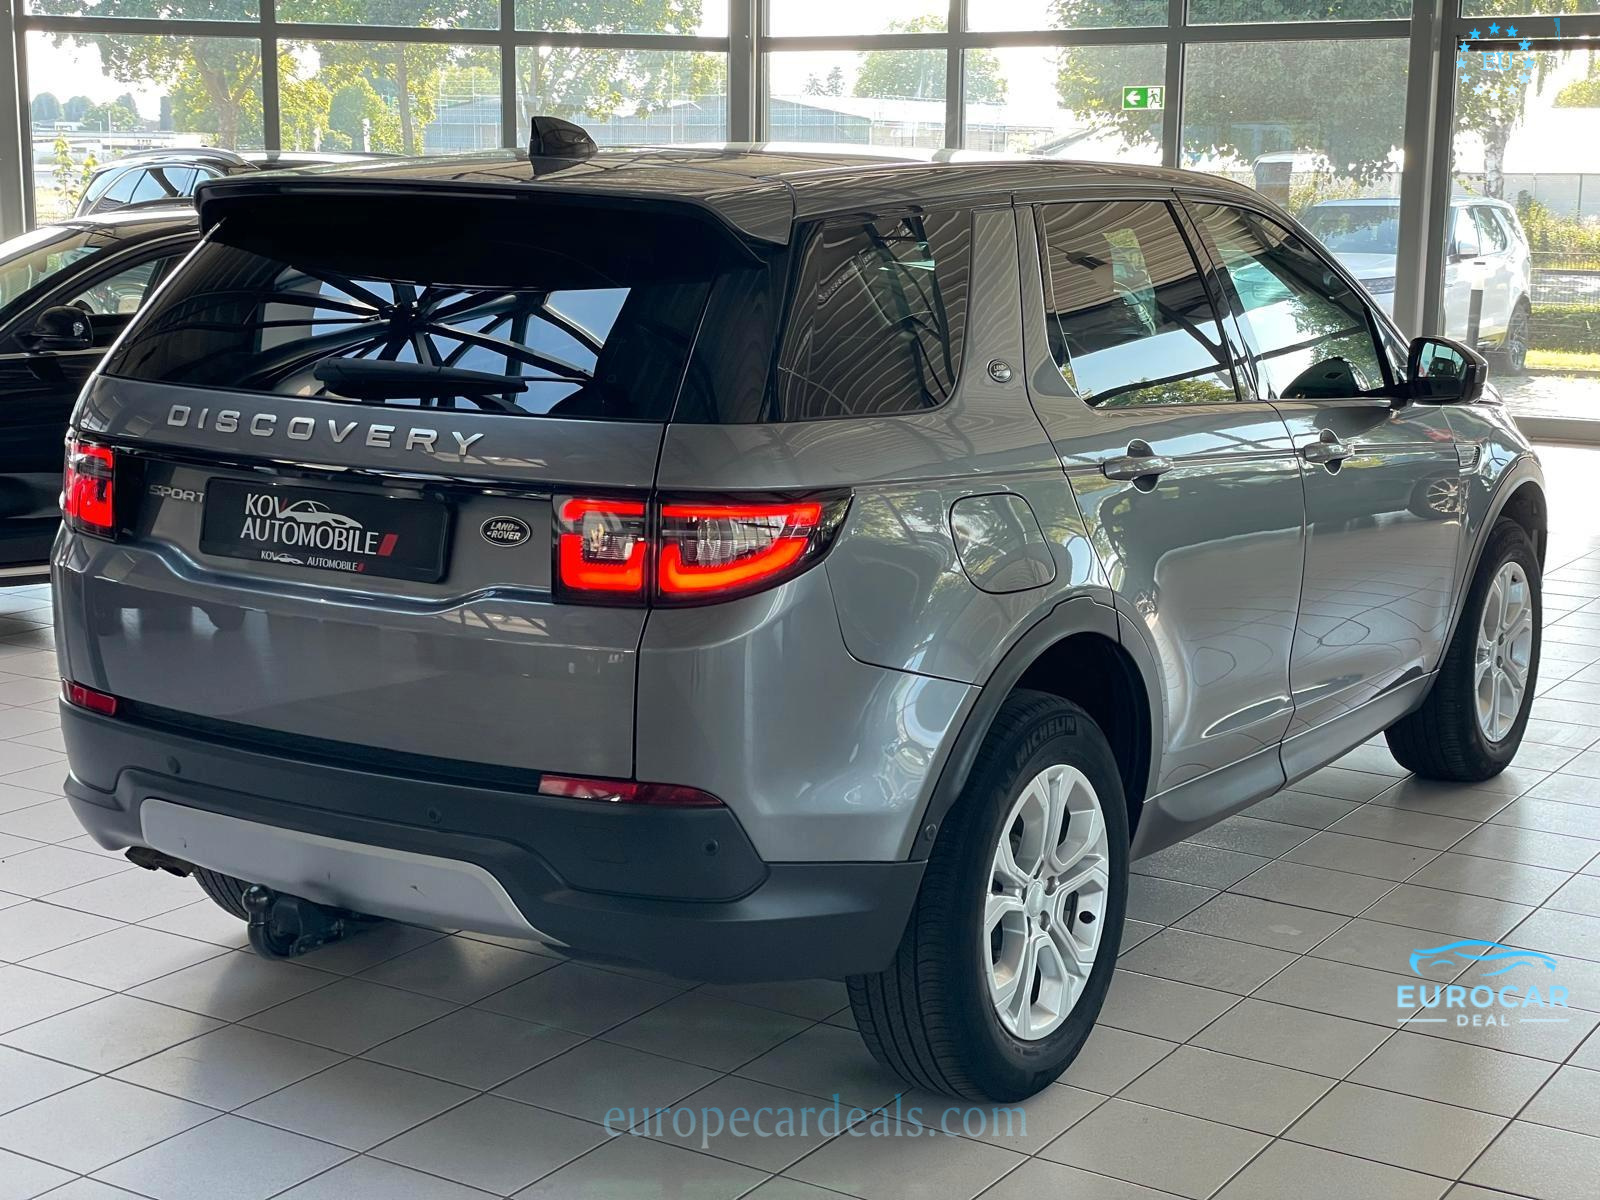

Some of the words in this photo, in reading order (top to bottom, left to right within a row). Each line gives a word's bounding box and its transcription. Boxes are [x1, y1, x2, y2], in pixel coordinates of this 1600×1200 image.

[167, 404, 484, 456] DISCOVERY
[149, 484, 205, 503] SPORT
[244, 494, 288, 518] KOV
[240, 517, 379, 555] AUTOMOBILE
[490, 521, 515, 531] LAND
[490, 530, 521, 540] ROVER
[306, 556, 358, 572] AUTOMOBILE
[1015, 716, 1076, 769] MICHELIN
